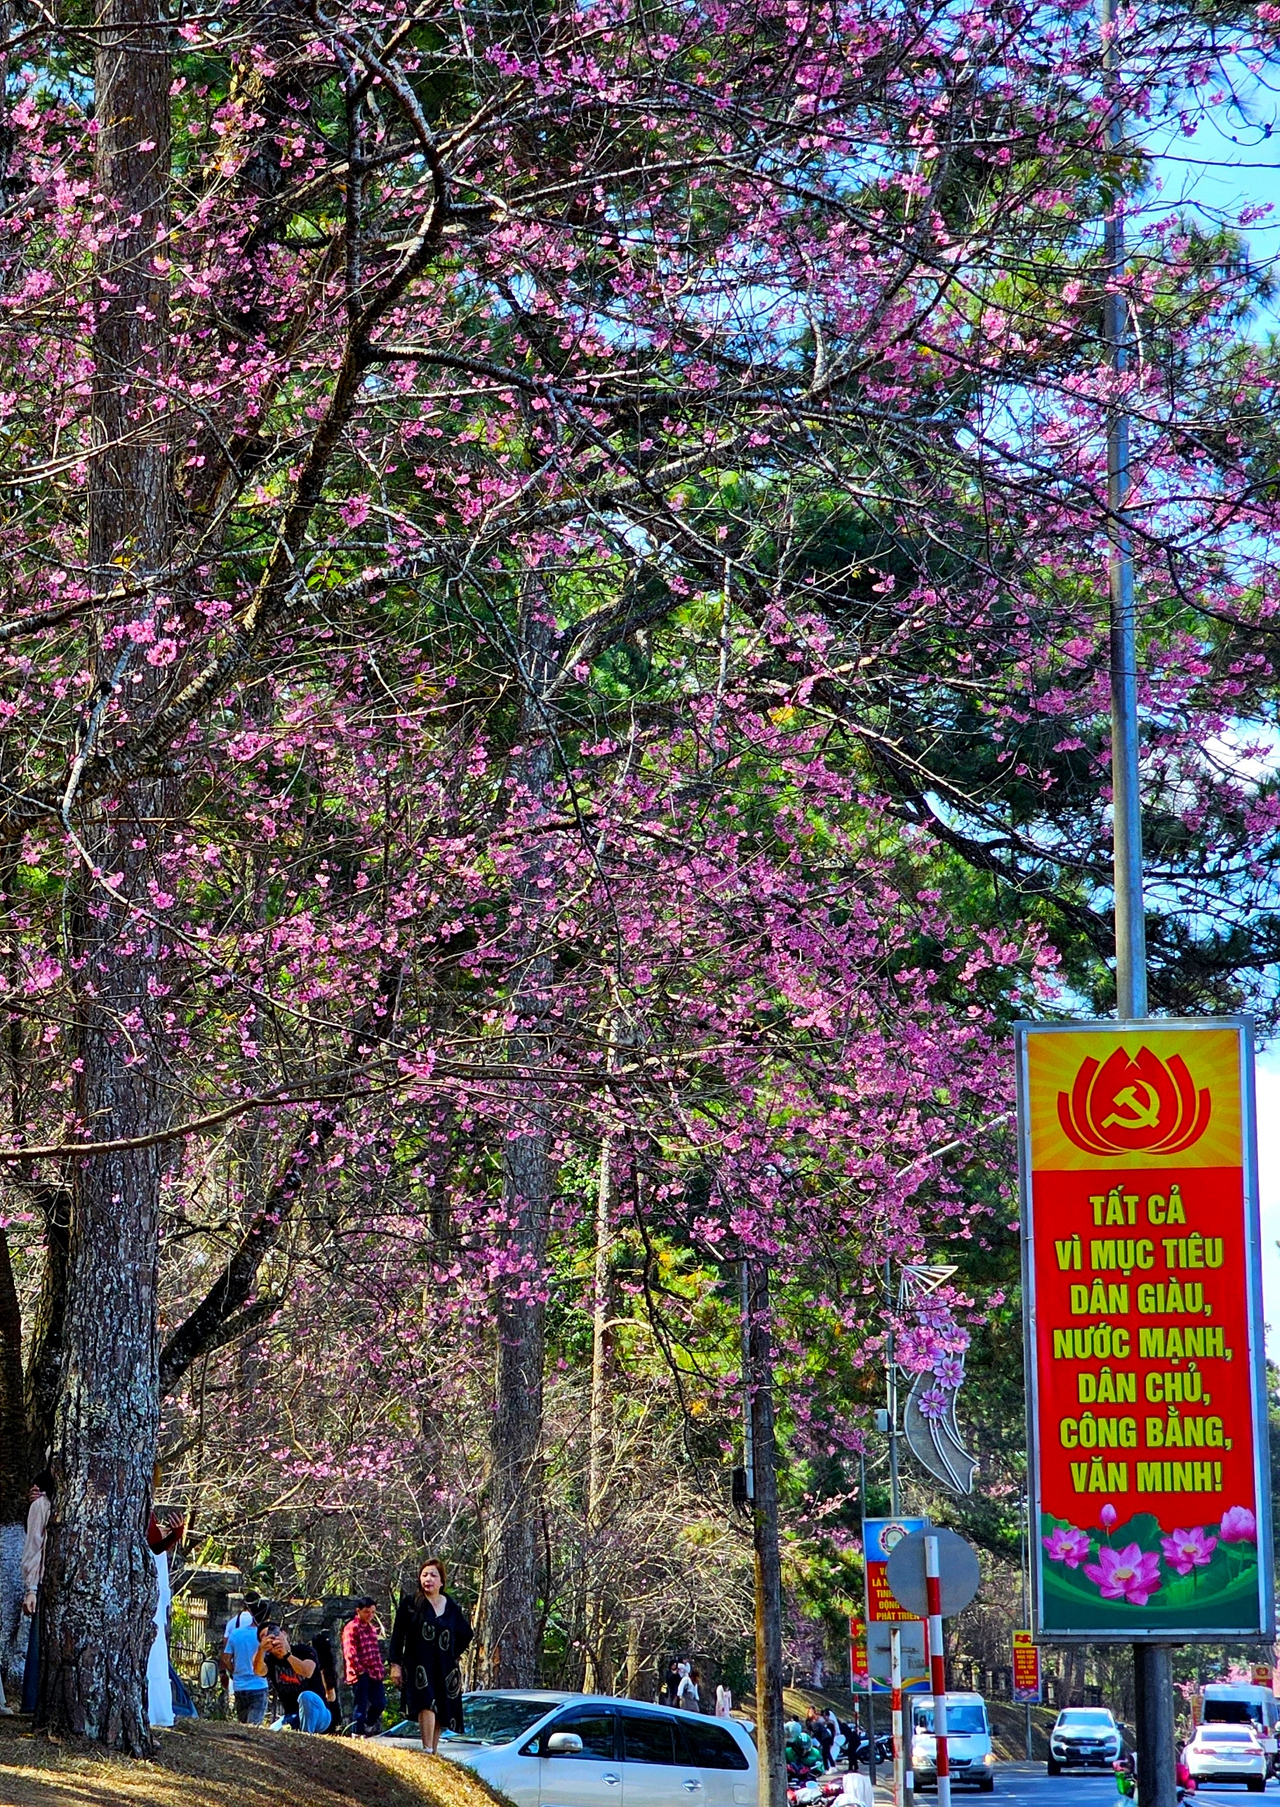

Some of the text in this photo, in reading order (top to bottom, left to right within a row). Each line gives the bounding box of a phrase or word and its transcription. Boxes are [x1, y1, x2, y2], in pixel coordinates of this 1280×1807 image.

[1089, 1183, 1186, 1226] TẤT CẢ
[1054, 1231, 1224, 1276] VÌ MỤC TIÊU
[1070, 1276, 1212, 1317] DÂN GIÀU,
[1053, 1321, 1233, 1365] NƯỚC MẠNH,
[1078, 1361, 1211, 1406] DÂN CHỦ,
[1059, 1405, 1232, 1451] CÔNG BẰNG,
[1070, 1455, 1223, 1493] VĂN MINH!
